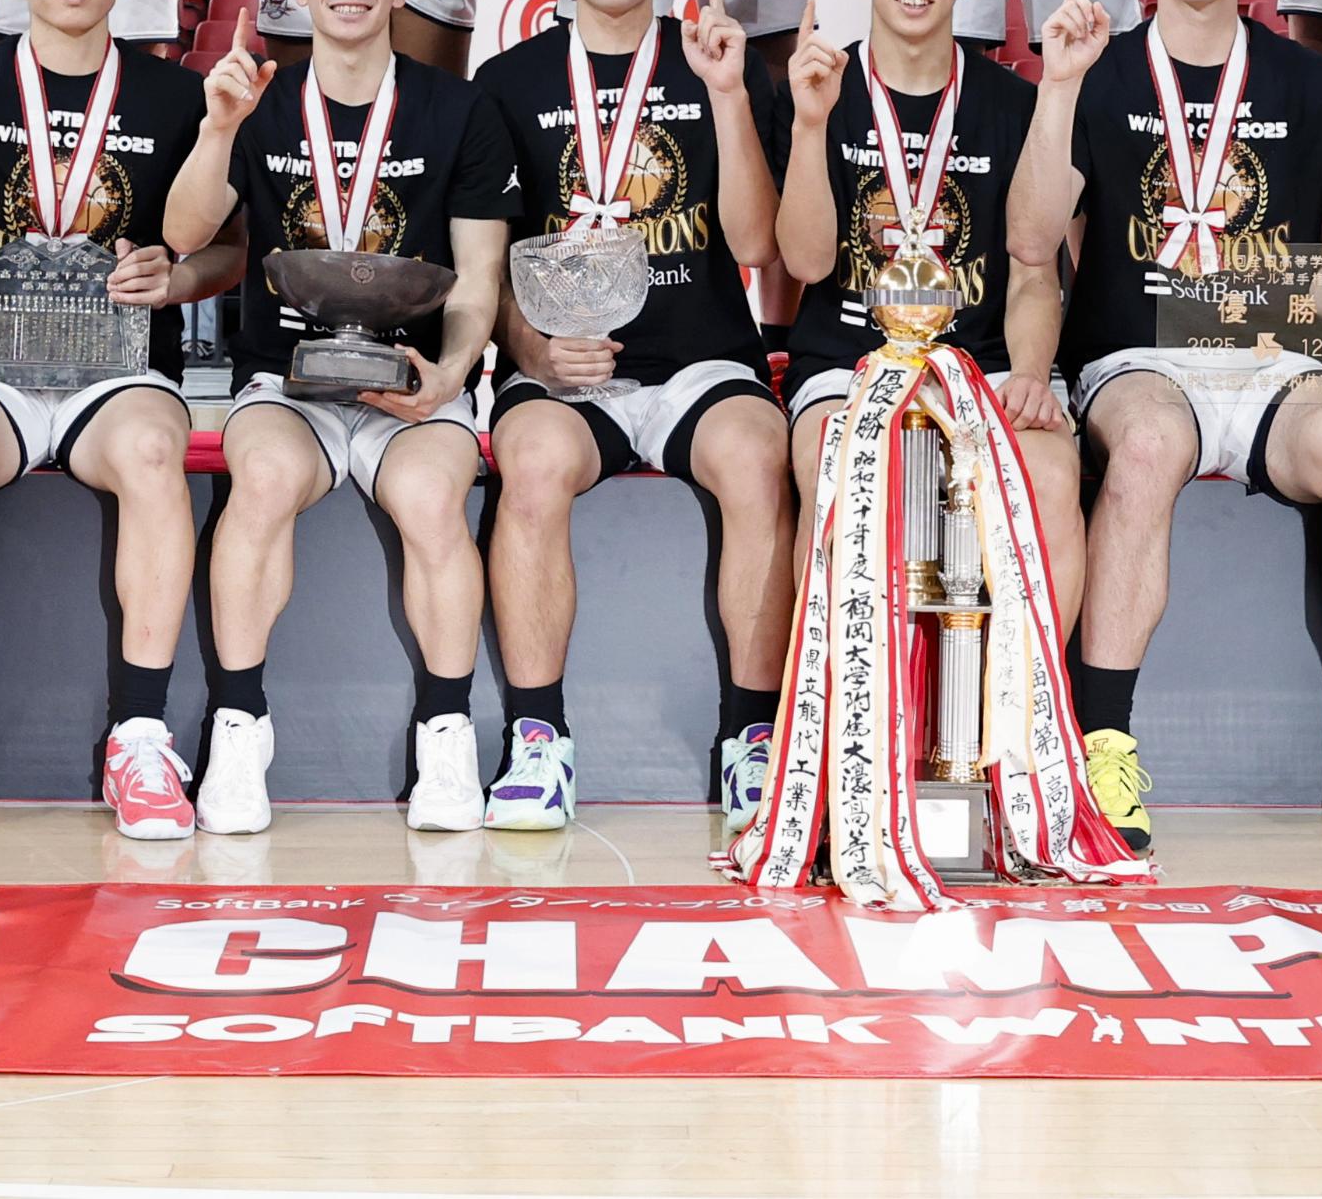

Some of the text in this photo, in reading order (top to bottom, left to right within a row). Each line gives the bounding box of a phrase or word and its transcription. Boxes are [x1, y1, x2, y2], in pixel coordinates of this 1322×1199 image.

[651, 104, 701, 121] 2025
[1237, 122, 1288, 139] 2025
[105, 136, 155, 155] 2025
[379, 158, 425, 178] 2025
[947, 156, 991, 174] 2025
[646, 264, 692, 286] Bank
[1187, 337, 1237, 356] 2025
[154, 897, 367, 911] SoftBank
[85, 1003, 890, 1045] SOFTBANK
